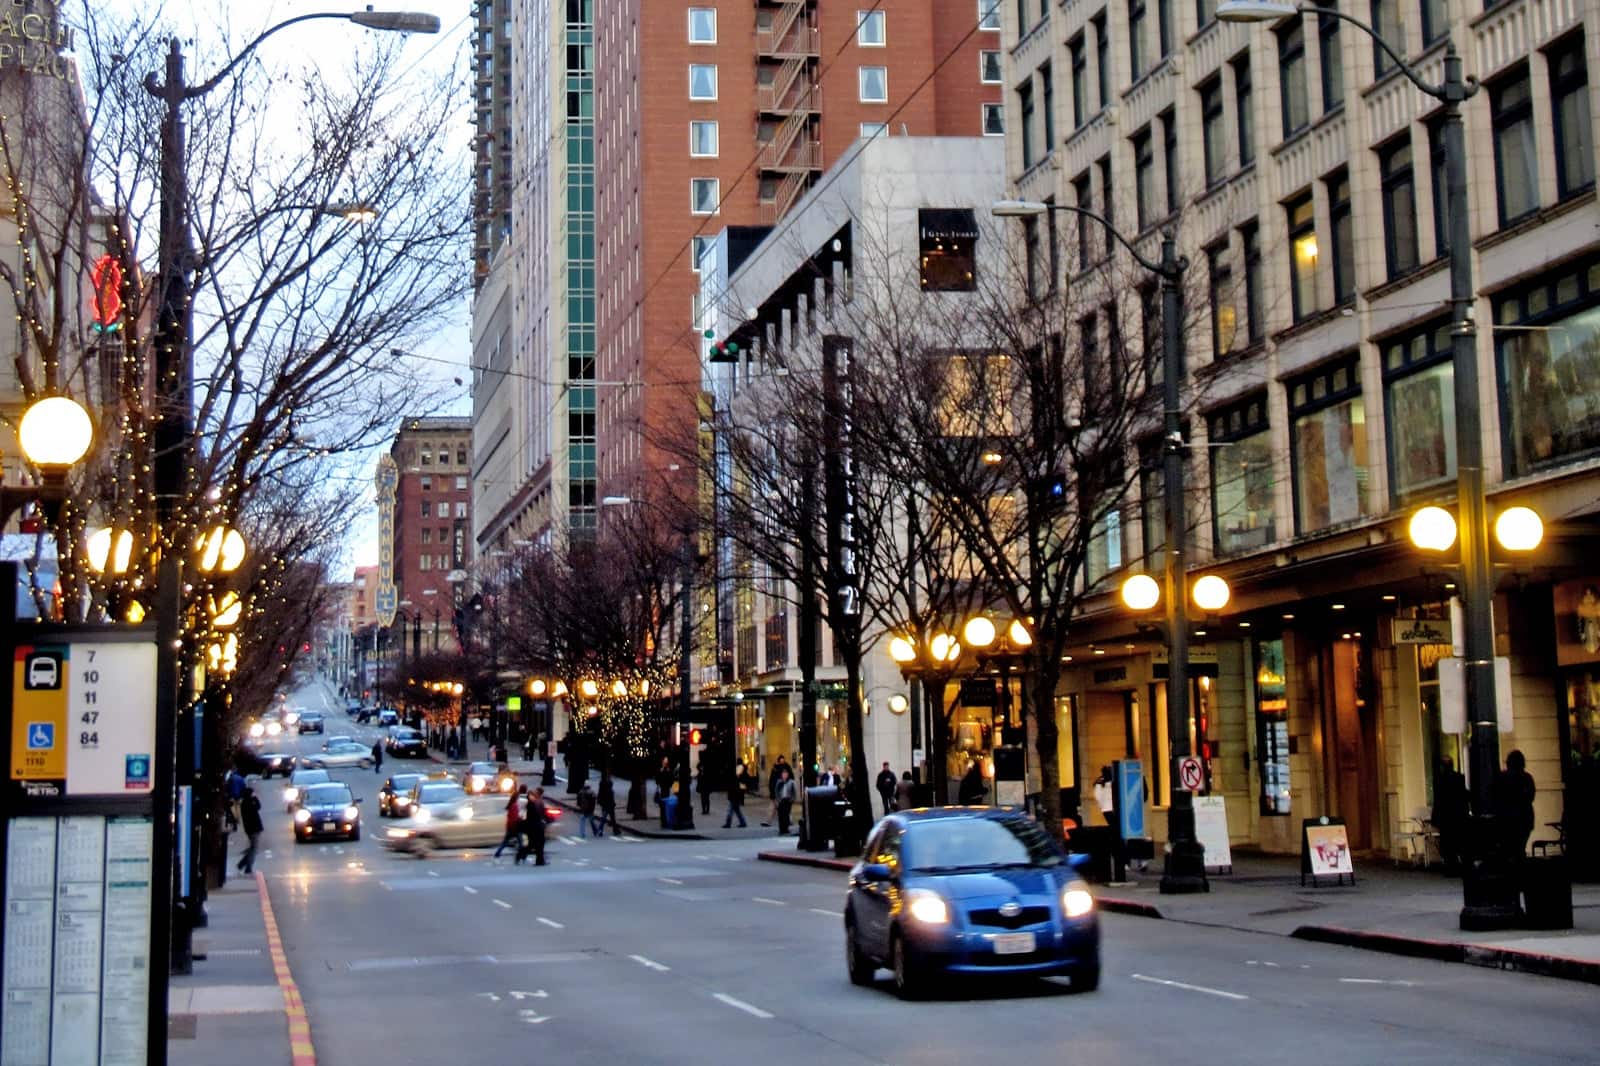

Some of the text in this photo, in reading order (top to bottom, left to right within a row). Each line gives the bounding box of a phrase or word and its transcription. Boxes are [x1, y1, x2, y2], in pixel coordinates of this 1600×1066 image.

[87, 650, 96, 663] 7
[83, 671, 99, 683] 10
[85, 692, 97, 704] 11
[81, 712, 99, 724] 47
[80, 732, 98, 745] 84
